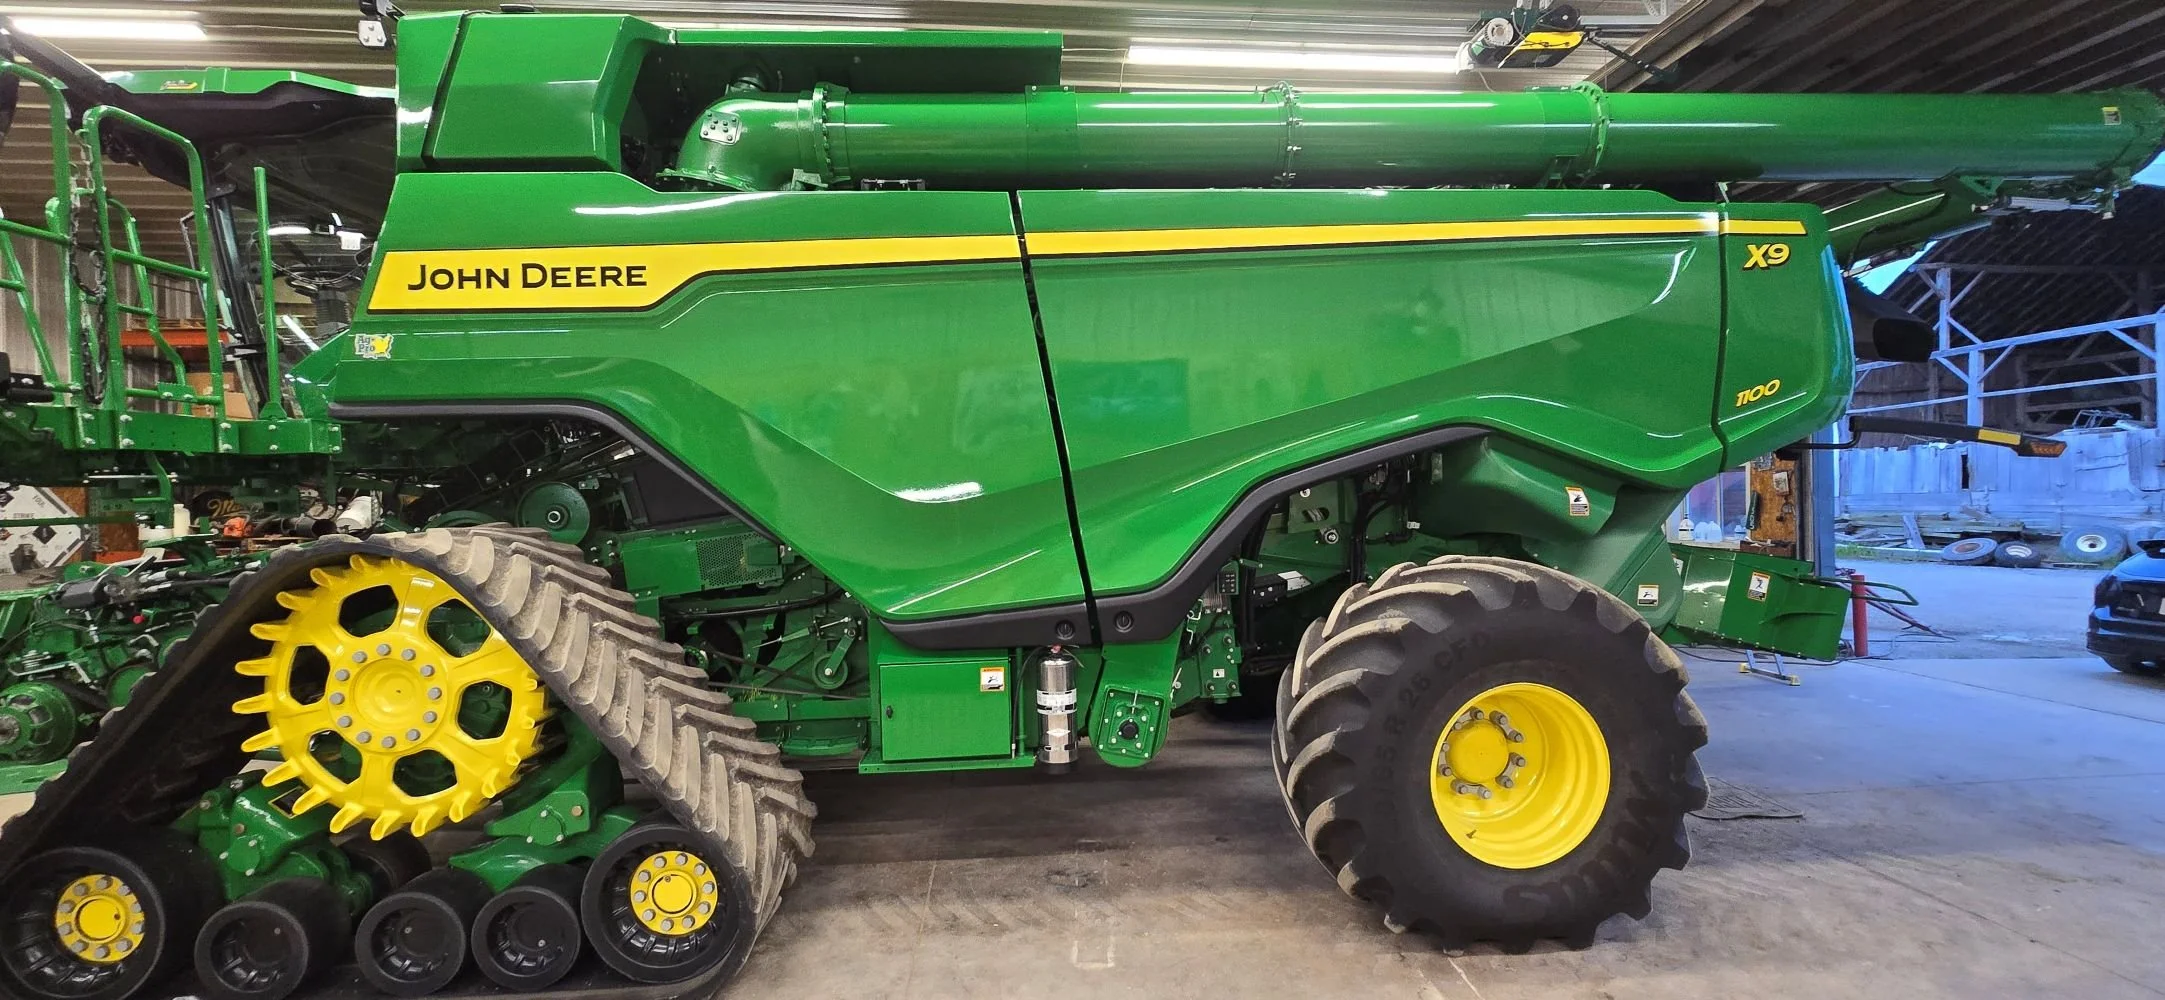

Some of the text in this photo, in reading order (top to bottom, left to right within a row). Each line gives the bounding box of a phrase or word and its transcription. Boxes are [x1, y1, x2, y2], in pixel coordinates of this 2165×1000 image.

[1743, 243, 1790, 269] X9
[407, 262, 647, 291] JOHN DEERE
[1735, 379, 1780, 407] 1100
